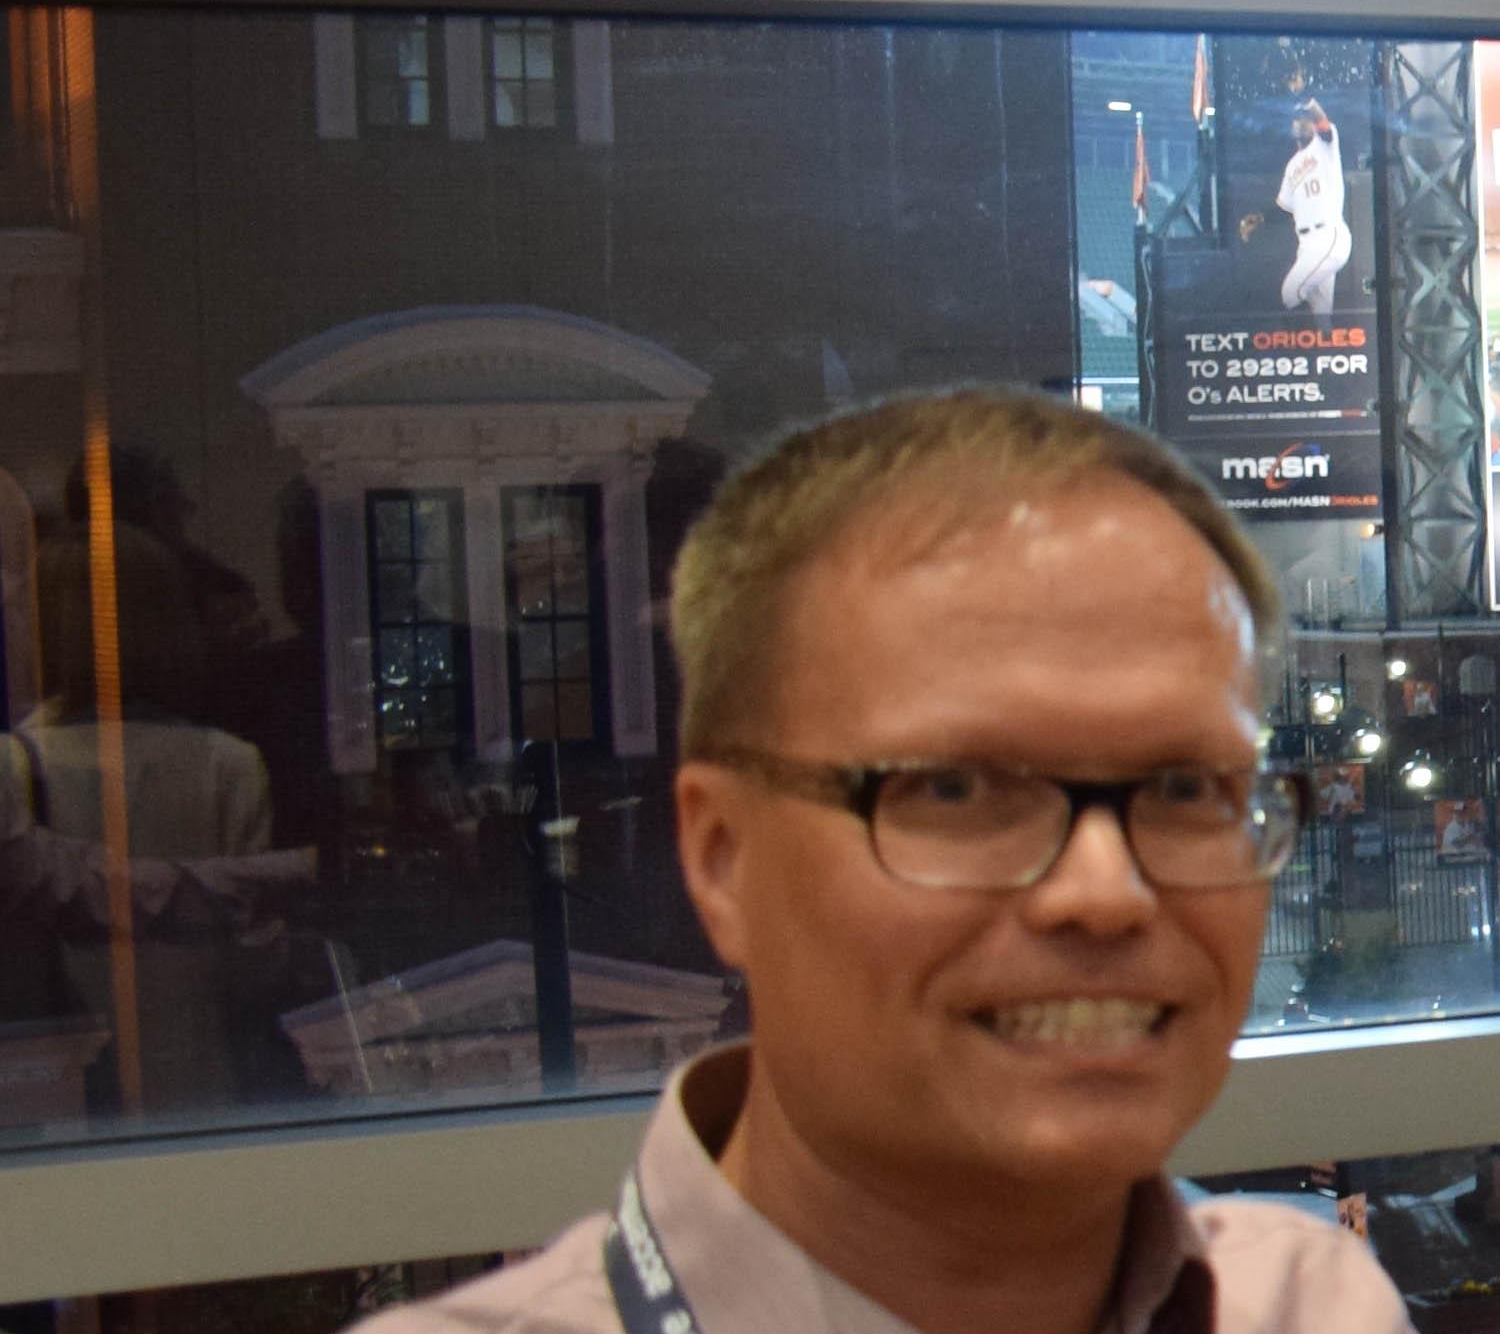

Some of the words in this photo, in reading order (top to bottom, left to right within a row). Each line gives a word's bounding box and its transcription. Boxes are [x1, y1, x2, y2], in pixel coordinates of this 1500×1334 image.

[1304, 179, 1321, 198] 10
[1185, 332, 1249, 352] TEXT
[1252, 328, 1366, 349] ORIOLES
[1186, 359, 1219, 378] TO
[1226, 356, 1309, 377] 29292
[1316, 354, 1368, 374] FOR
[1187, 386, 1222, 405] O's
[1226, 382, 1325, 403] ALERTS.
[1221, 455, 1329, 479] masn
